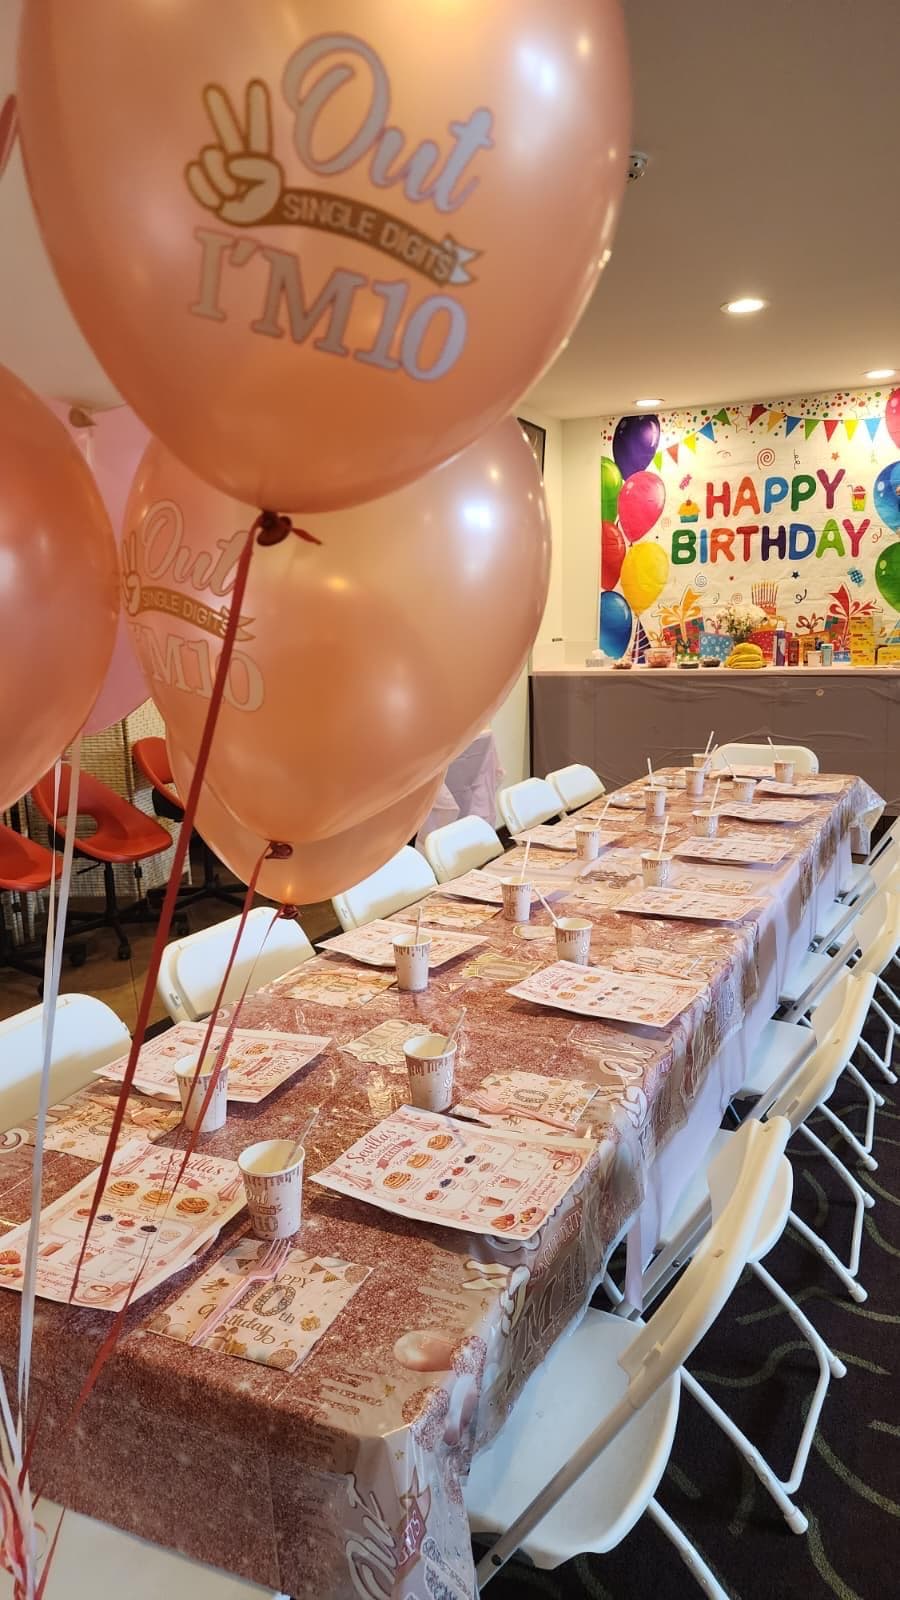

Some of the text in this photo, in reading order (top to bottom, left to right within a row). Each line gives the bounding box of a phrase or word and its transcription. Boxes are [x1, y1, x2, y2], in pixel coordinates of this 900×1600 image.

[282, 32, 494, 214] Out
[282, 193, 456, 281] SINGLE DIGITS
[706, 468, 846, 520] HAPPY
[143, 500, 252, 597] Out
[671, 518, 871, 565] BIRTHDAY
[161, 1152, 225, 1176] Seilla's
[272, 1273, 315, 1289] PPY
